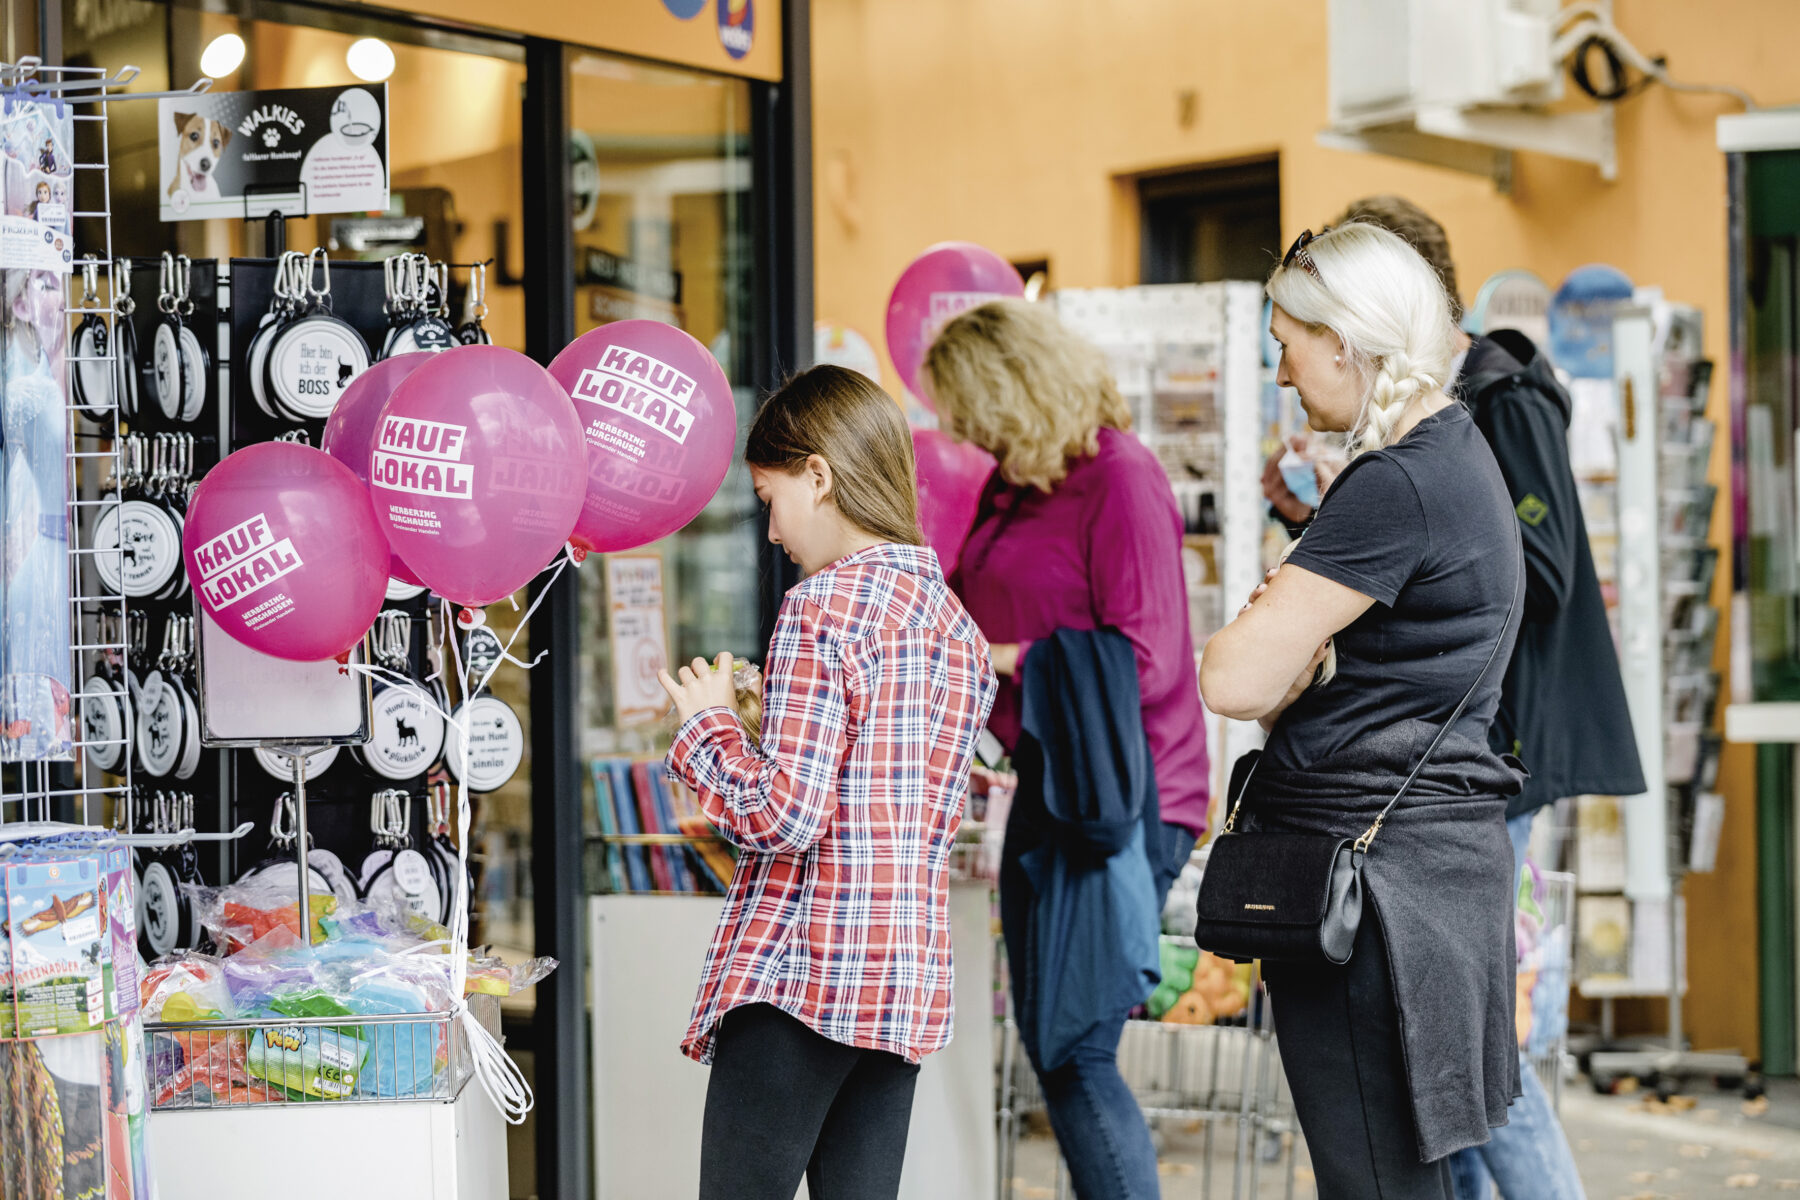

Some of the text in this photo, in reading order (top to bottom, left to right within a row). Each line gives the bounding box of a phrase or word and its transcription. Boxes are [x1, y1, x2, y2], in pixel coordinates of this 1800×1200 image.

[237, 104, 305, 137] WALKIES
[319, 344, 333, 359] bin
[314, 361, 327, 375] der
[602, 348, 694, 397] KAUF
[298, 379, 330, 395] BOSS
[577, 372, 687, 438] LOKAL
[382, 419, 463, 454] KAUF
[585, 426, 646, 458] BURGHAUSEN
[592, 419, 646, 443] WERBERING
[373, 455, 467, 494] LOKAL
[388, 513, 442, 529] BURGHAUSEN
[389, 504, 437, 519] WERBERING
[197, 518, 265, 575] KAUF
[204, 549, 297, 607] LOKAL
[242, 593, 286, 620] WERBERING
[245, 598, 294, 628] BURGHAUSEN
[385, 701, 404, 716] Hund
[388, 750, 422, 763] glücklich
[17, 960, 79, 985] STEINADLER
